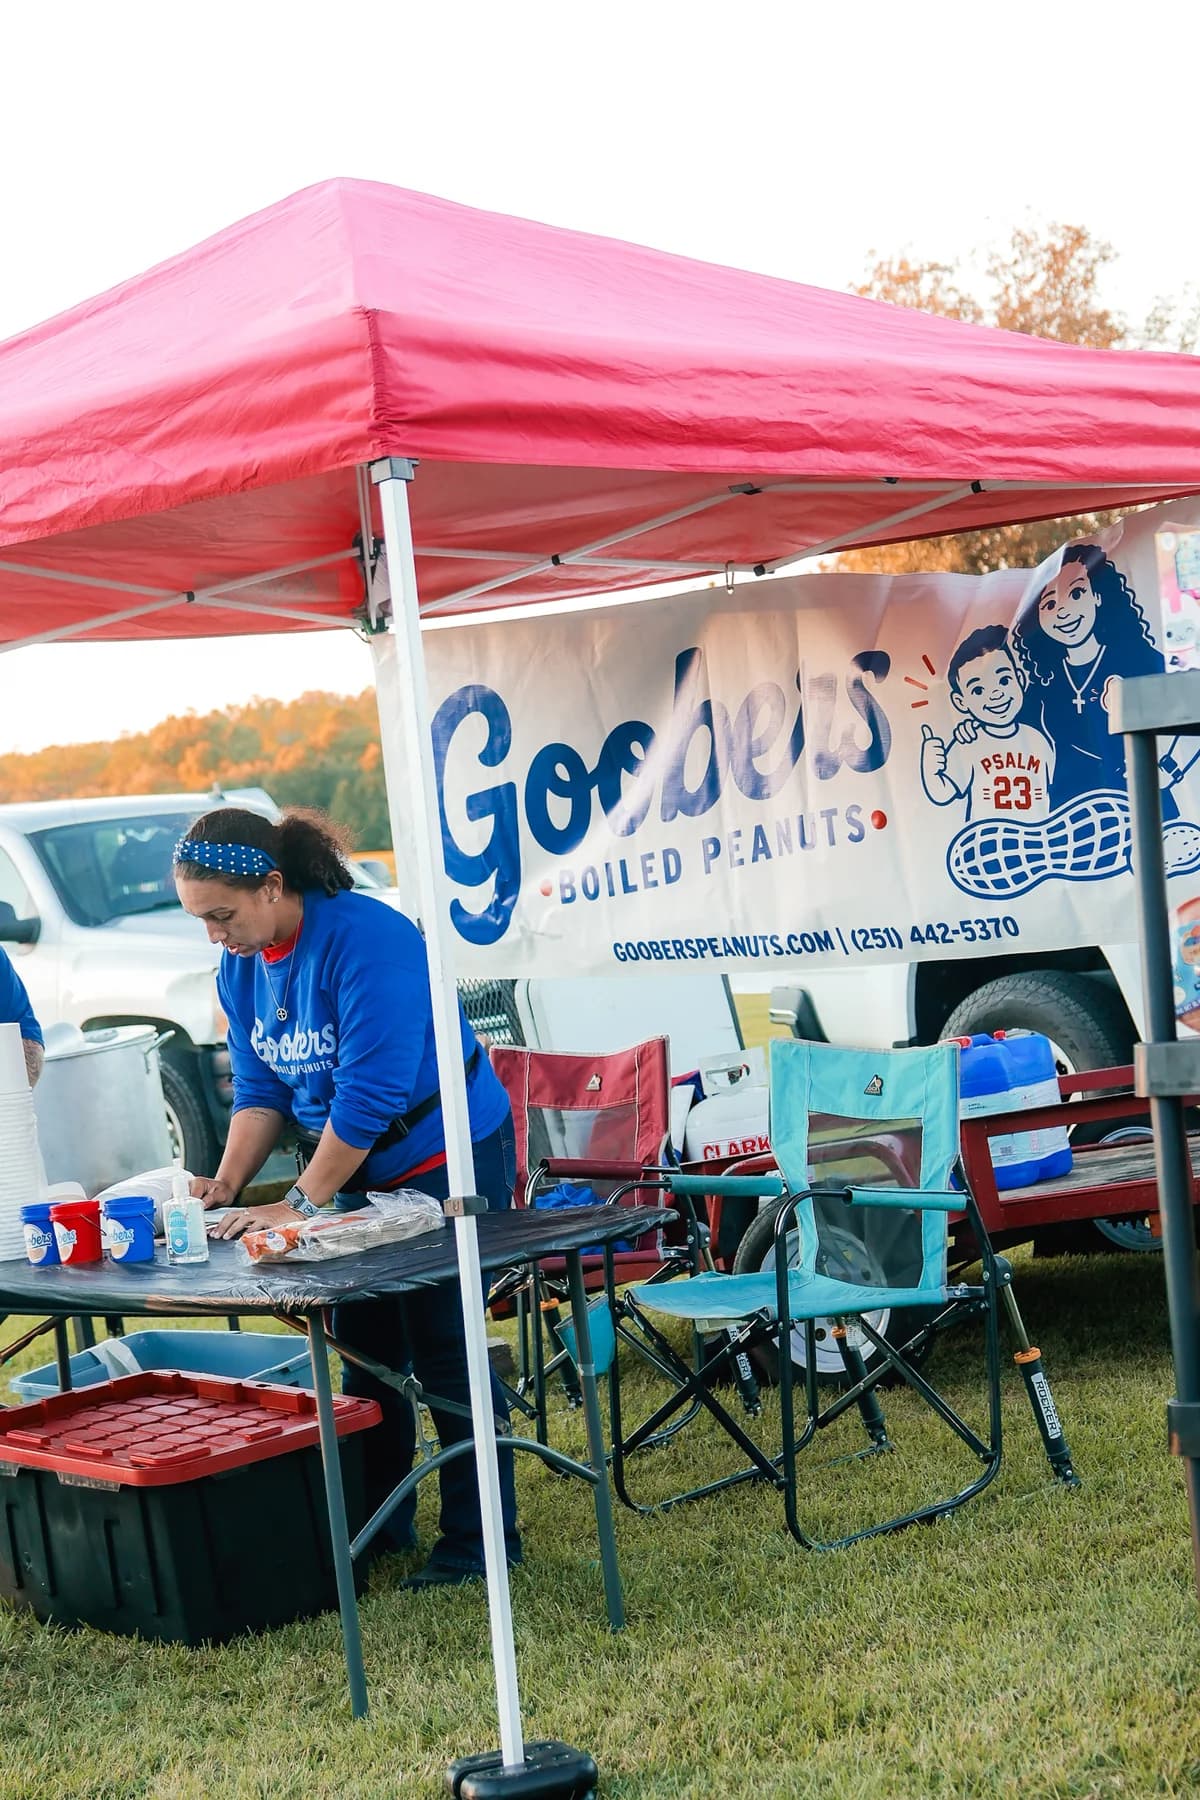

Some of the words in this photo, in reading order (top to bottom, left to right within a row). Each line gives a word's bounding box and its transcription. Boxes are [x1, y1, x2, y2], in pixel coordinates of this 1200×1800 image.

[980, 752, 1041, 774] PSALM
[431, 646, 892, 945] Goobers
[993, 776, 1032, 810] 23
[560, 847, 682, 904] BOILED
[701, 804, 866, 875] PEANUTS
[612, 930, 835, 962] GOOBERSPEANUTS.COM
[851, 927, 904, 952] (251)
[910, 916, 1020, 945] 442-5370
[1035, 1380, 1057, 1432] ROCKER
